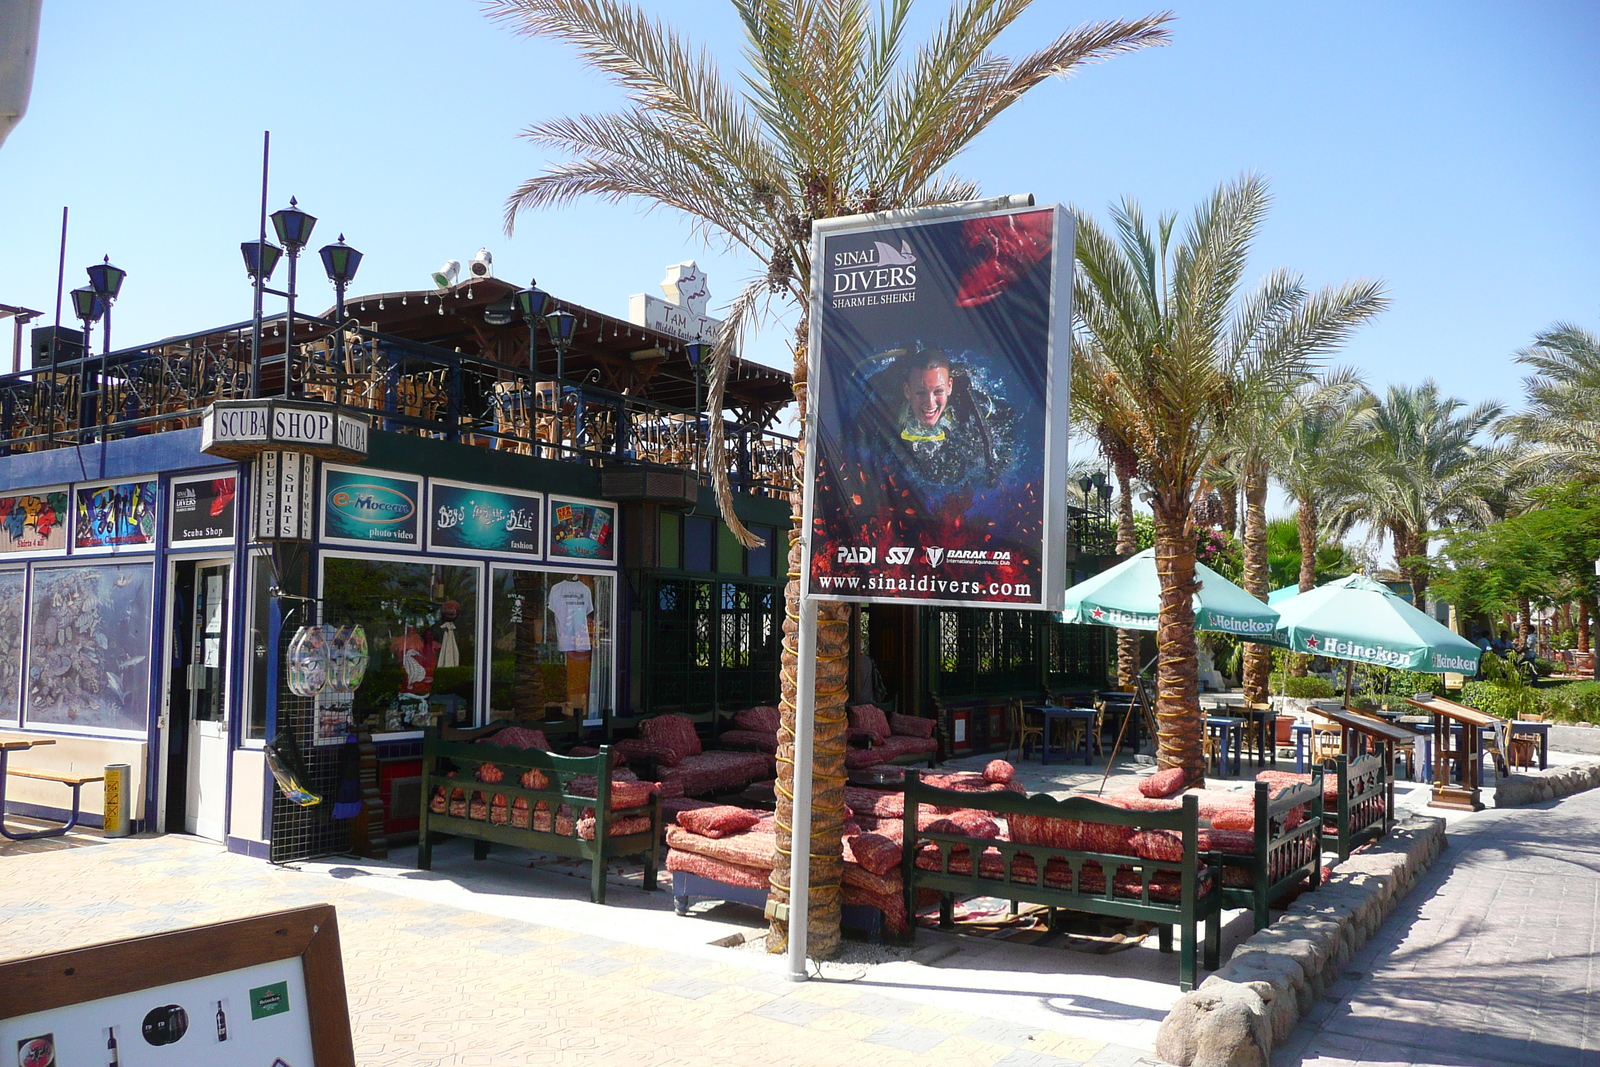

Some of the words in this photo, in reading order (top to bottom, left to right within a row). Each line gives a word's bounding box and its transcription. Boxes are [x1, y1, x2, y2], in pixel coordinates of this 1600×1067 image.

[835, 249, 874, 266] SINAI
[833, 266, 916, 293] DIVERS
[832, 297, 865, 308] SHARM
[867, 296, 879, 305] EL
[880, 292, 915, 304] SHEIKH
[664, 306, 686, 328] TAM
[655, 321, 676, 336] Middle
[220, 411, 266, 437] SCUBA
[275, 411, 328, 440] SHOP
[339, 420, 365, 452] SCUBA
[266, 452, 275, 486] BLUE
[265, 491, 275, 534] STUFF
[183, 529, 203, 537] Scuba
[205, 527, 223, 536] Shop
[369, 528, 392, 538] photo
[393, 530, 414, 540] video
[510, 540, 534, 550] fashion
[838, 547, 876, 564] PADI
[885, 547, 915, 565] SSI
[946, 550, 1011, 560] BARAKUDA
[819, 573, 1031, 596] www.sinaidivers.com
[1108, 609, 1158, 625] Heine
[1216, 614, 1274, 632] Heineken
[1324, 637, 1411, 666] Heineken
[1436, 654, 1476, 671] Heineken
